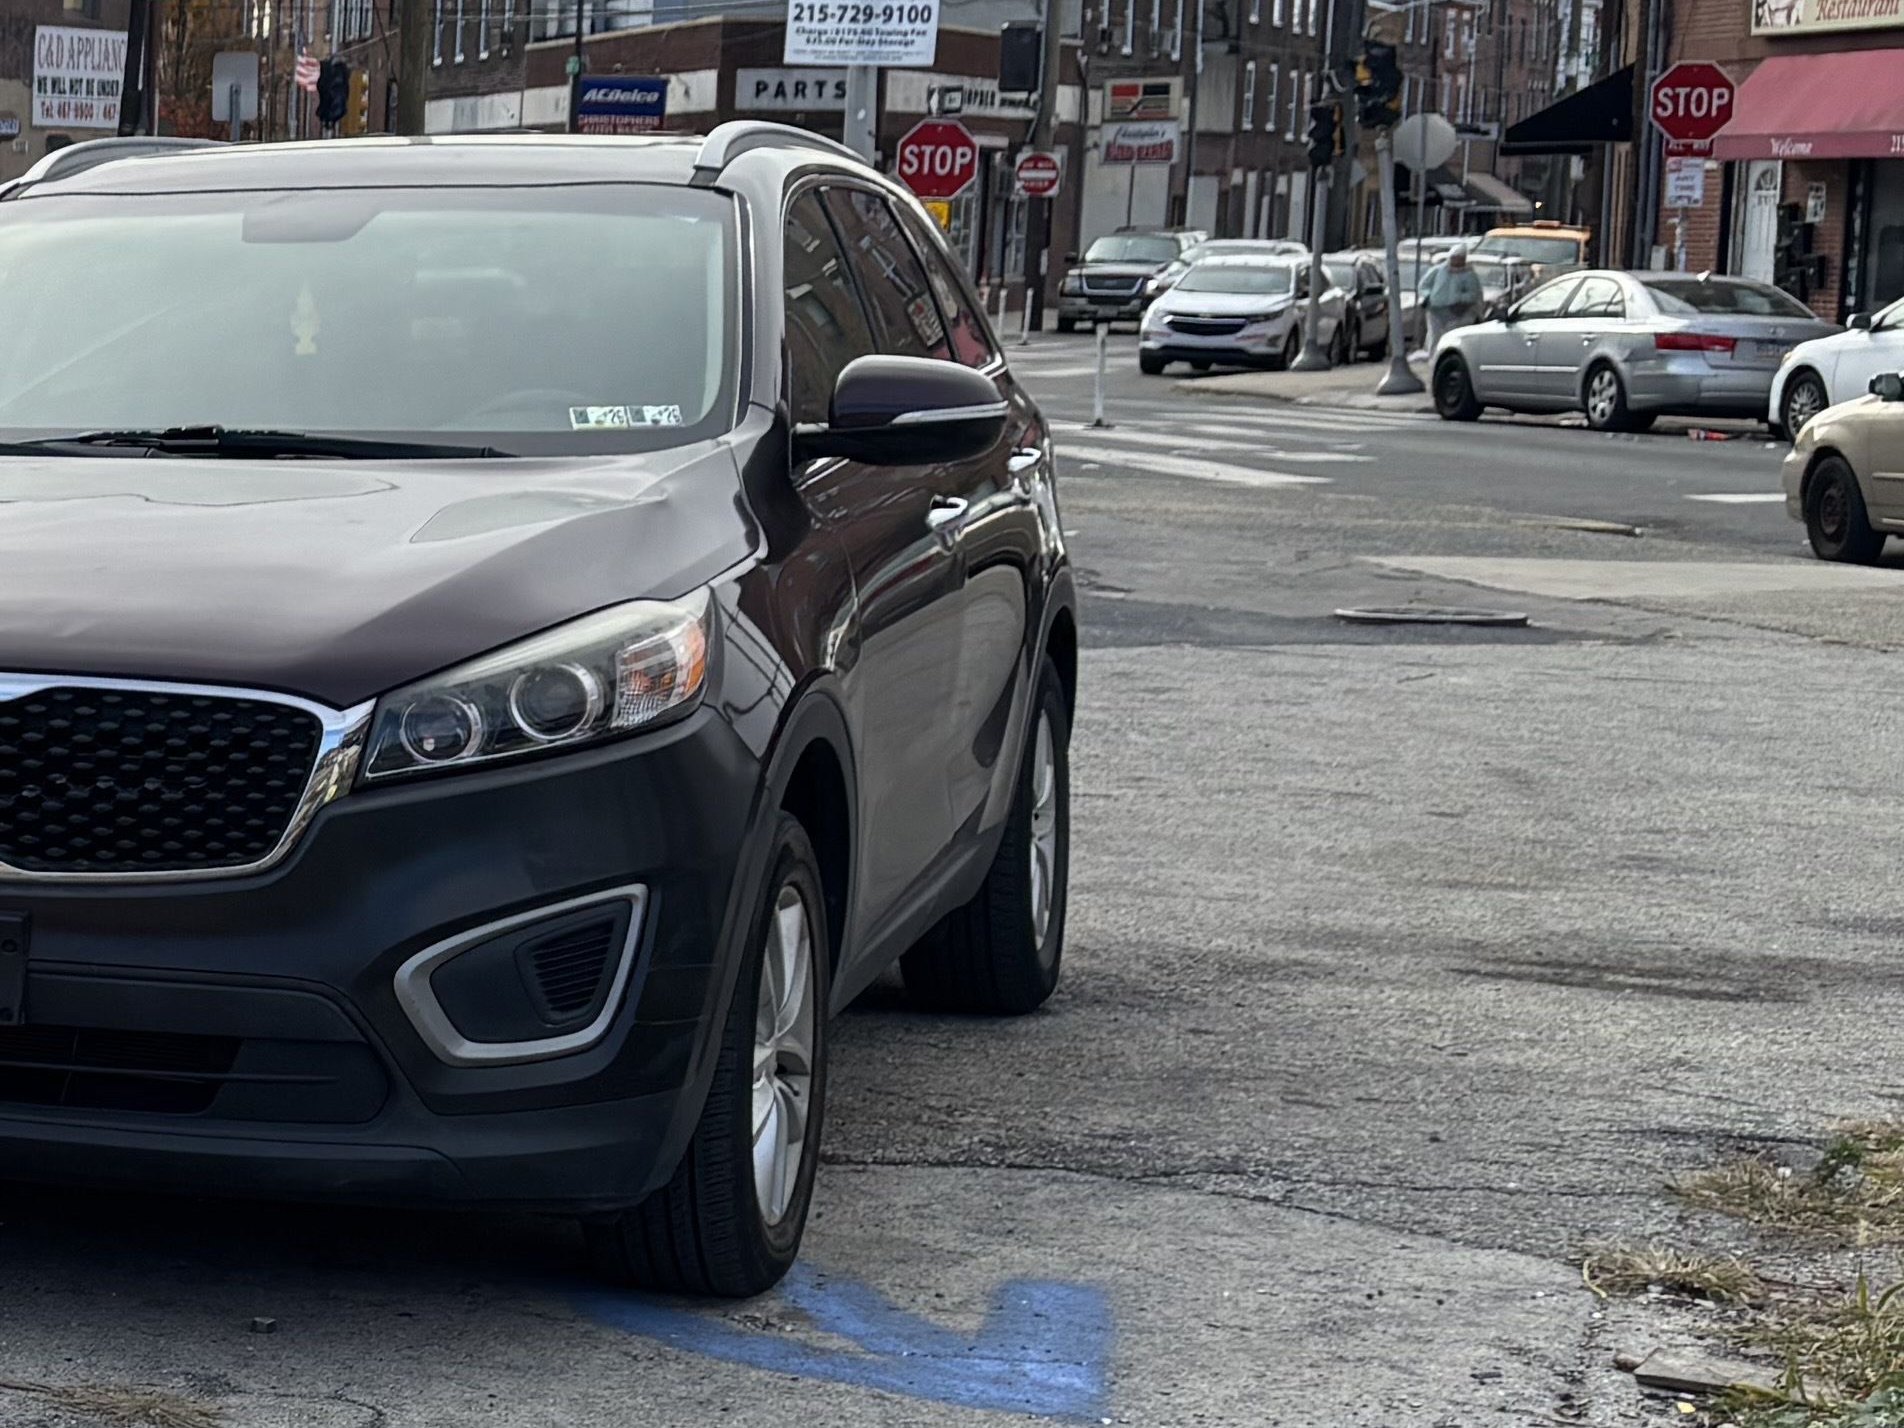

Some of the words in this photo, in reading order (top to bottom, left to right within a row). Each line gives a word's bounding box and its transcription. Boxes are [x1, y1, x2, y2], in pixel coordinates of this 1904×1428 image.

[793, 3, 932, 23] 215-729-9100
[755, 79, 847, 101] PARTS
[1656, 87, 1731, 118] STOP
[1770, 137, 1813, 156] Welcome
[902, 144, 972, 177] STOP
